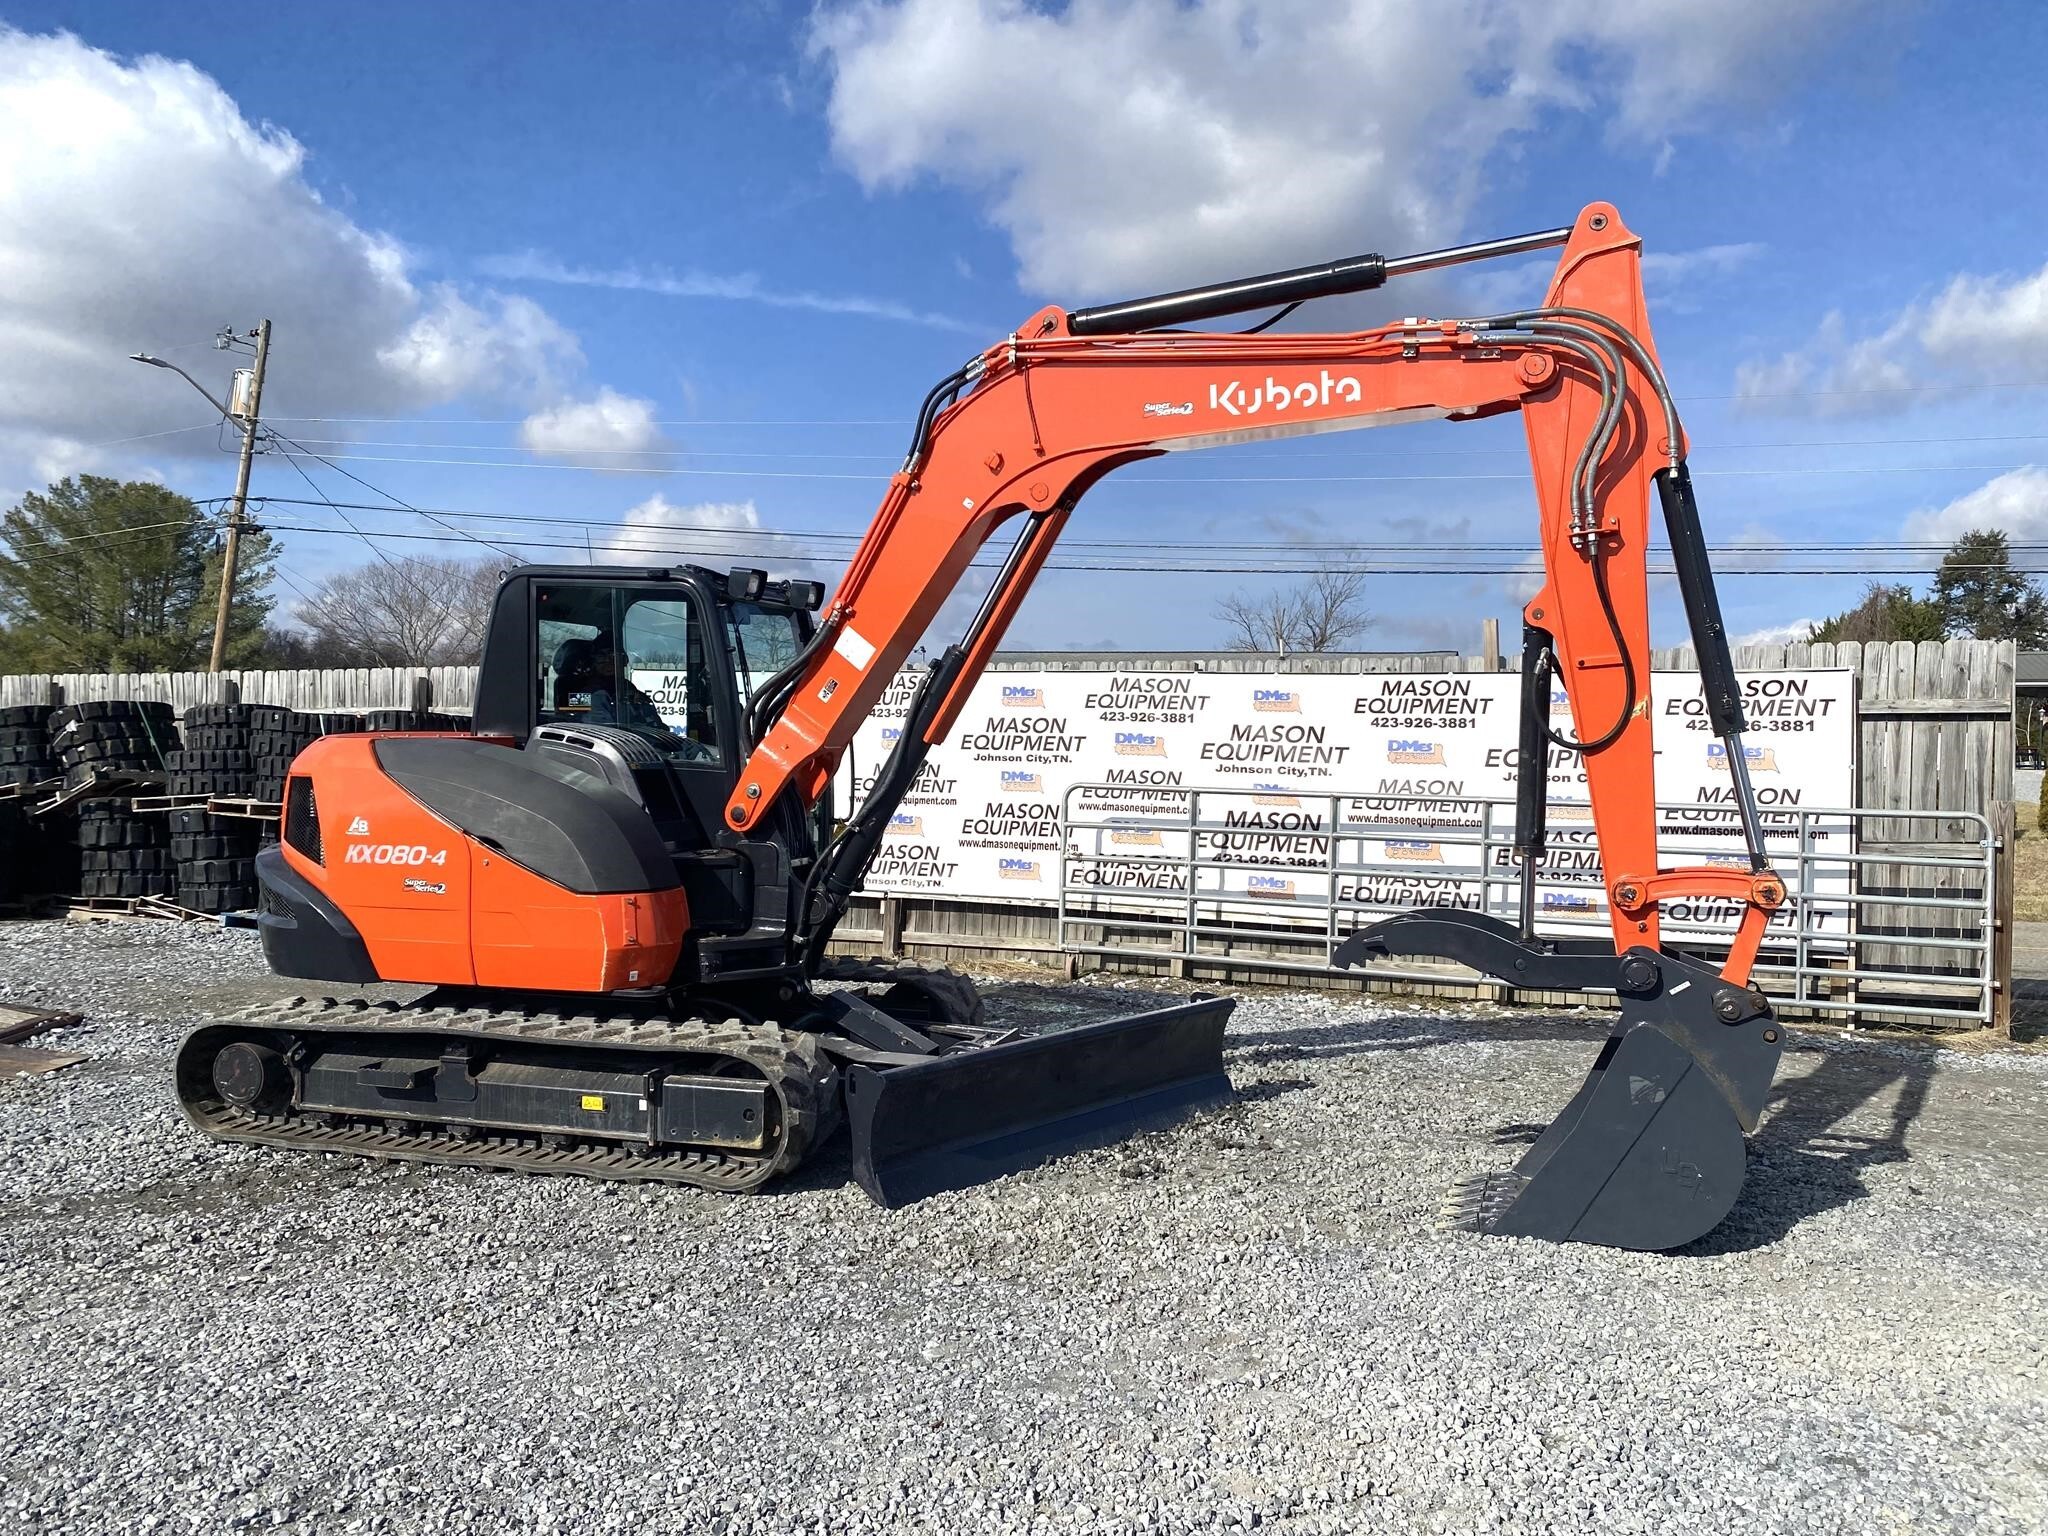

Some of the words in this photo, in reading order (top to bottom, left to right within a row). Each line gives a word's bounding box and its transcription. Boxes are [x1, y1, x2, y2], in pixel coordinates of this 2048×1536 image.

[1209, 370, 1362, 416] Kubota
[1109, 677, 1191, 694] MASON
[1381, 680, 1471, 697] MASON
[1084, 693, 1211, 711] EQUIPMENT
[1354, 698, 1494, 715] EQUIPMENT
[985, 717, 1067, 734] MASON
[1099, 711, 1195, 723] 423-926-3881
[1370, 717, 1476, 728] 423-926-3881
[1230, 724, 1326, 744] MASON
[960, 734, 1087, 752] EQUIPMENT
[973, 753, 1022, 762] Johnson
[1200, 743, 1350, 764] EQUIPMENT
[1105, 769, 1183, 786] MASON
[1215, 764, 1272, 774] Johnson
[1081, 787, 1188, 802] EQUIPMEN
[1378, 779, 1464, 796] MASON
[1696, 786, 1801, 805] MAON
[985, 803, 1060, 820] MASON
[1078, 801, 1190, 815] www.dmasonequipment.c
[1224, 810, 1322, 831] MASON
[958, 838, 1079, 852] www.dmasonequipment.m
[1198, 831, 1329, 855] QUIPMEN
[344, 844, 448, 866] KX080-4
[869, 860, 959, 878] UIPMENT
[404, 878, 427, 887] Super
[865, 877, 897, 886] hnson
[1070, 868, 1188, 890] EQUIPMEN
